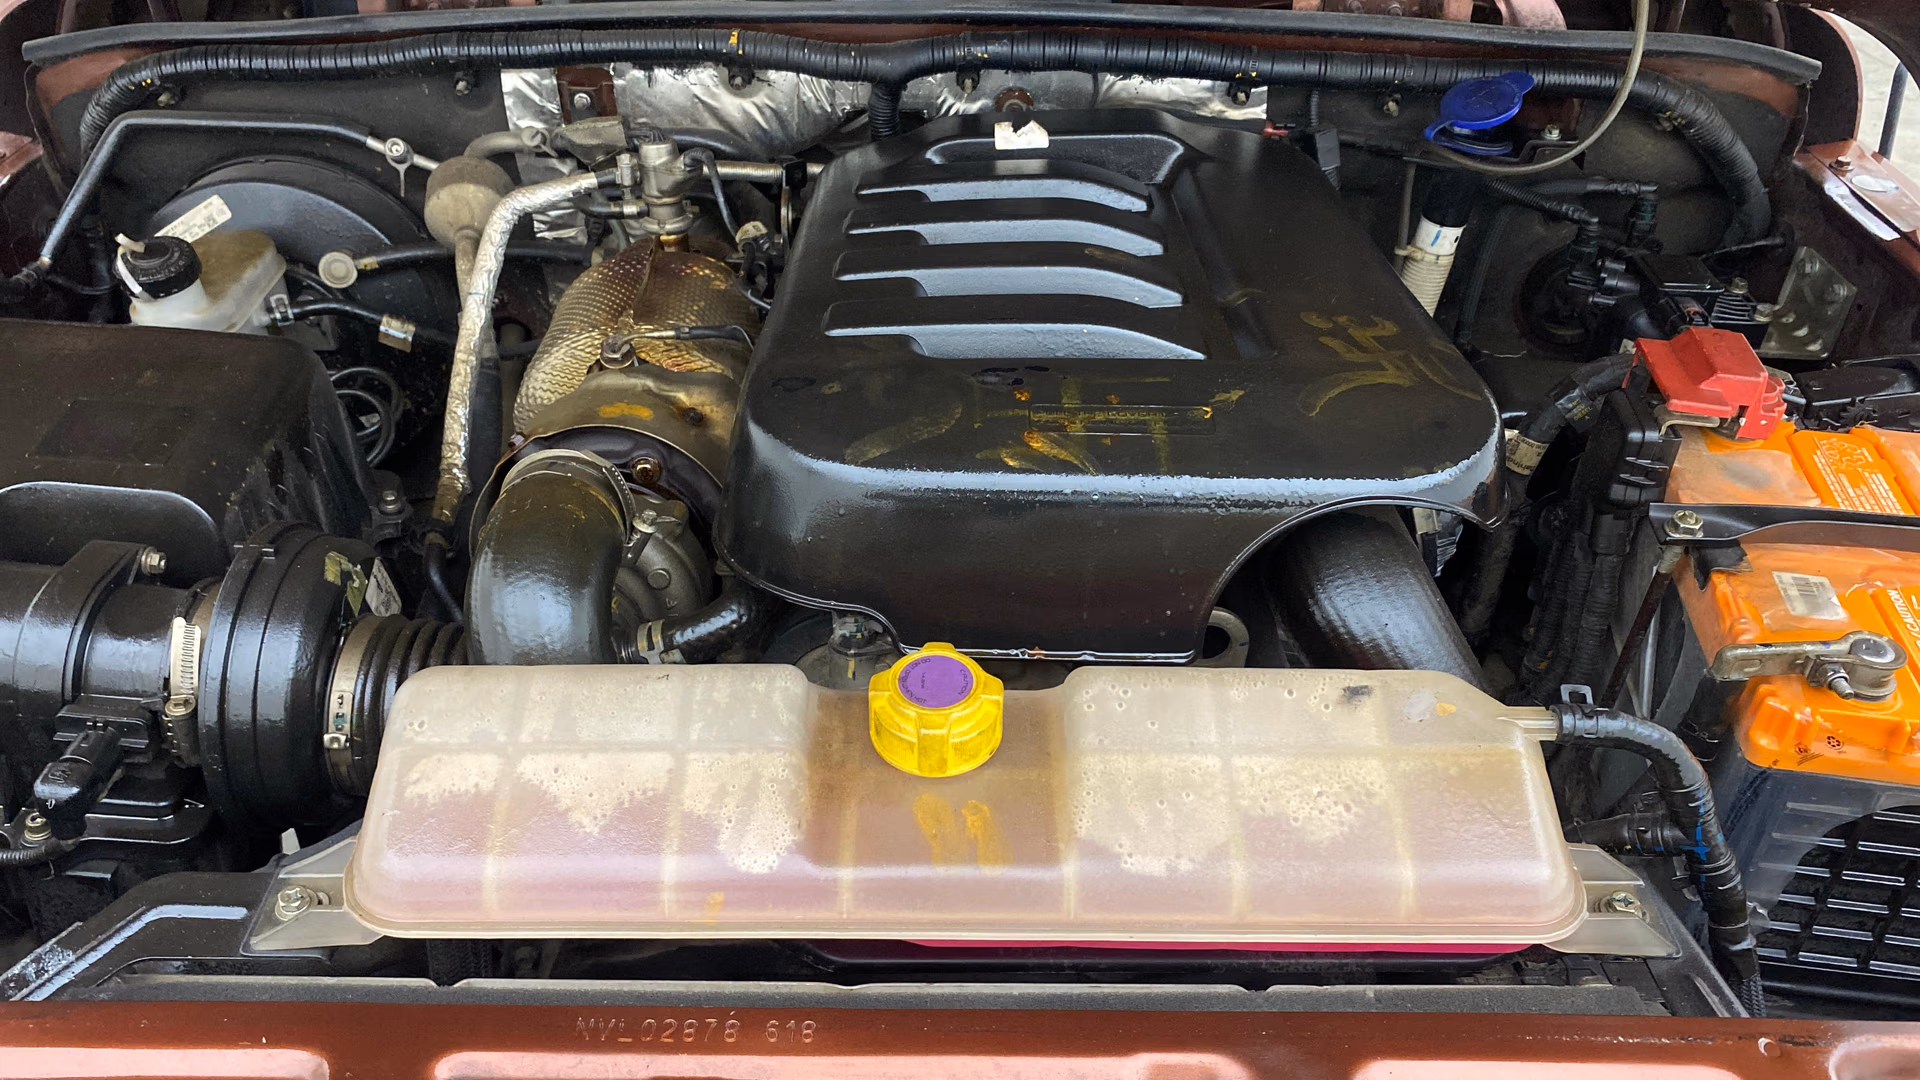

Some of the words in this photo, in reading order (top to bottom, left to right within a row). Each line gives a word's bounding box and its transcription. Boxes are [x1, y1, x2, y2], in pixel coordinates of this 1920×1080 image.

[909, 661, 921, 670] NOT
[958, 669, 969, 696] CAUTION
[914, 696, 927, 704] HOT
[765, 1019, 817, 1044] 618
